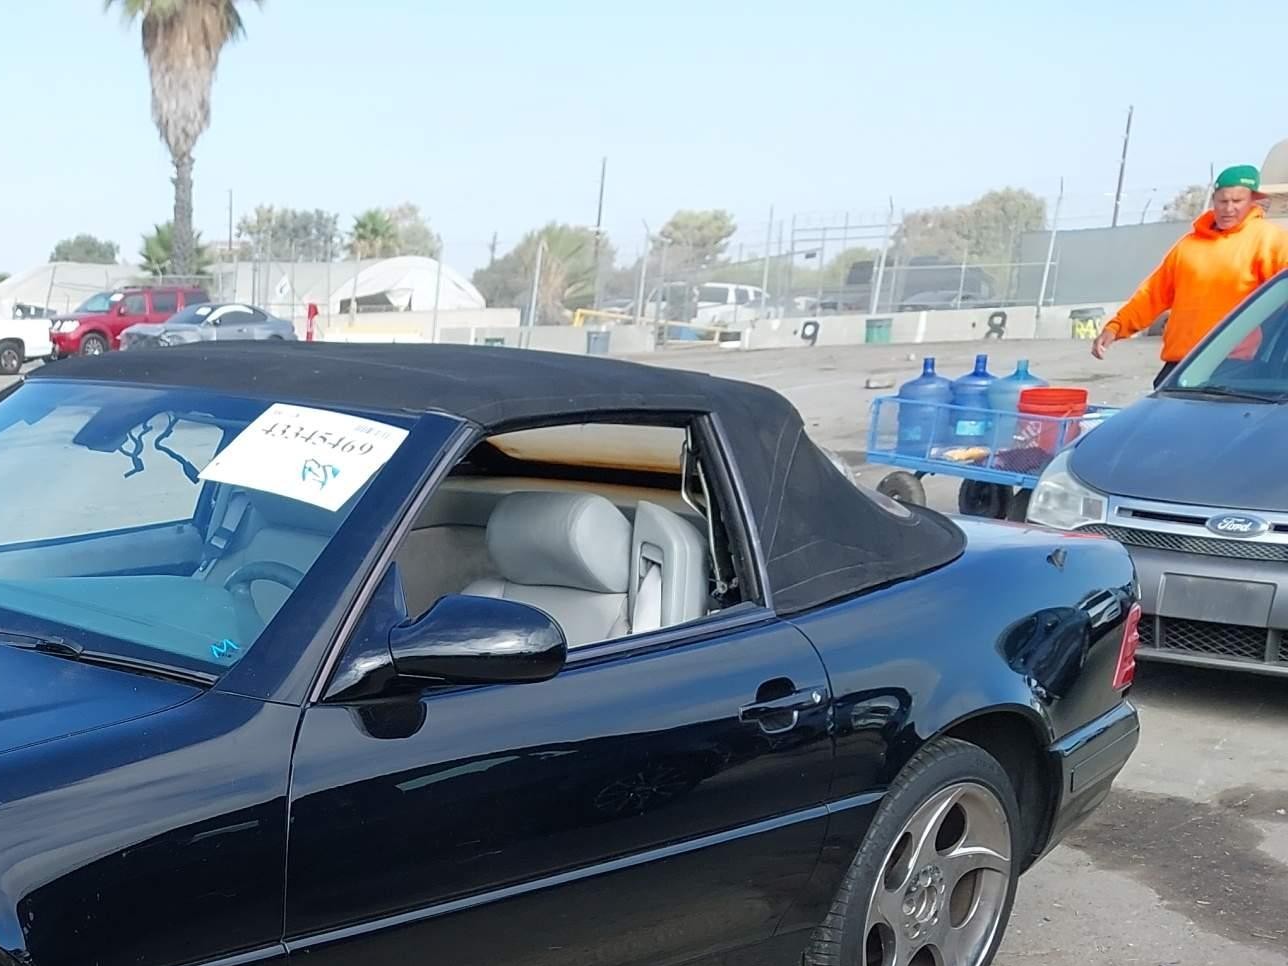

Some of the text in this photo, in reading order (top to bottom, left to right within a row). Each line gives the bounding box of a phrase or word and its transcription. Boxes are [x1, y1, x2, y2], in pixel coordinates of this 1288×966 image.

[801, 321, 820, 346] 9
[985, 311, 1007, 340] 8
[261, 422, 374, 456] 43345469
[1217, 516, 1253, 532] Ford
